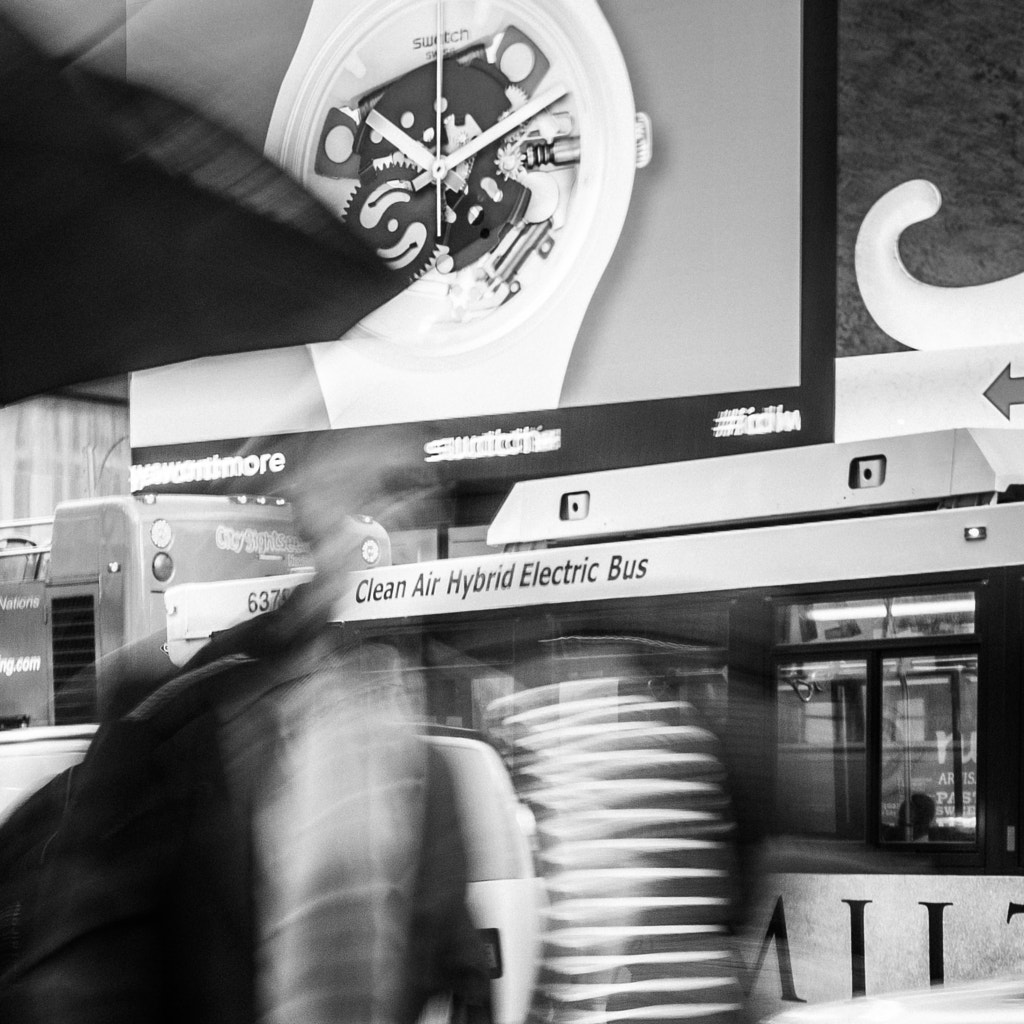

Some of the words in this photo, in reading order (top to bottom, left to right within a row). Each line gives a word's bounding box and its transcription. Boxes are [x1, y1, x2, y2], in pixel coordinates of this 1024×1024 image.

[356, 579, 407, 604] Clean
[411, 572, 442, 598] Air
[446, 563, 516, 600] Hybrid
[519, 555, 600, 588] Electric
[607, 554, 649, 582] Bus
